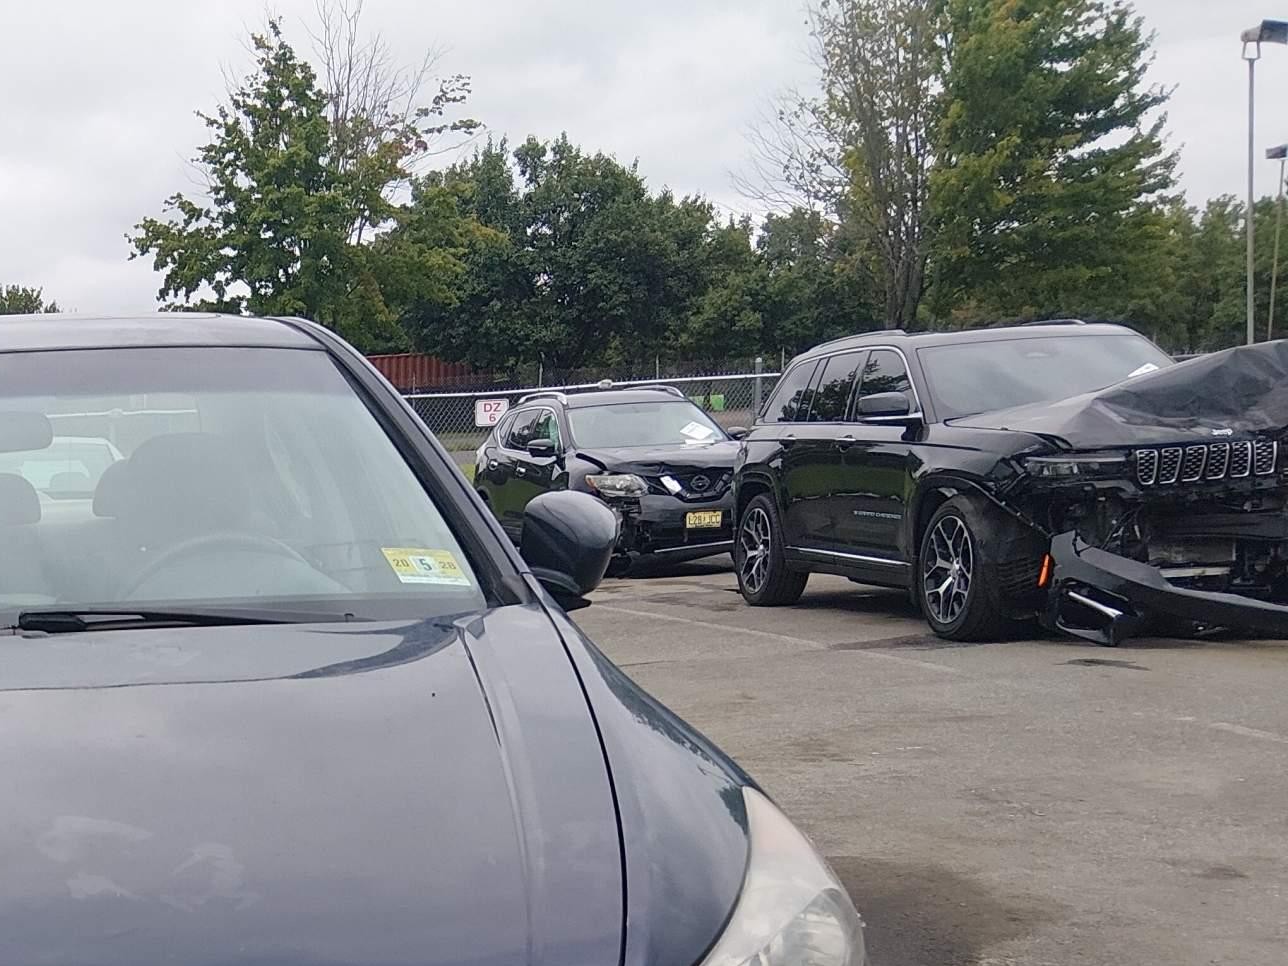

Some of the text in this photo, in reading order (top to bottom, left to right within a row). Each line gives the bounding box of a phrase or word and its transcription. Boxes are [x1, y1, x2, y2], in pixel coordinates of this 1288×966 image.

[483, 402, 502, 413] DZ
[489, 413, 497, 422] 6
[392, 558, 410, 568] 20
[419, 558, 432, 571] 5
